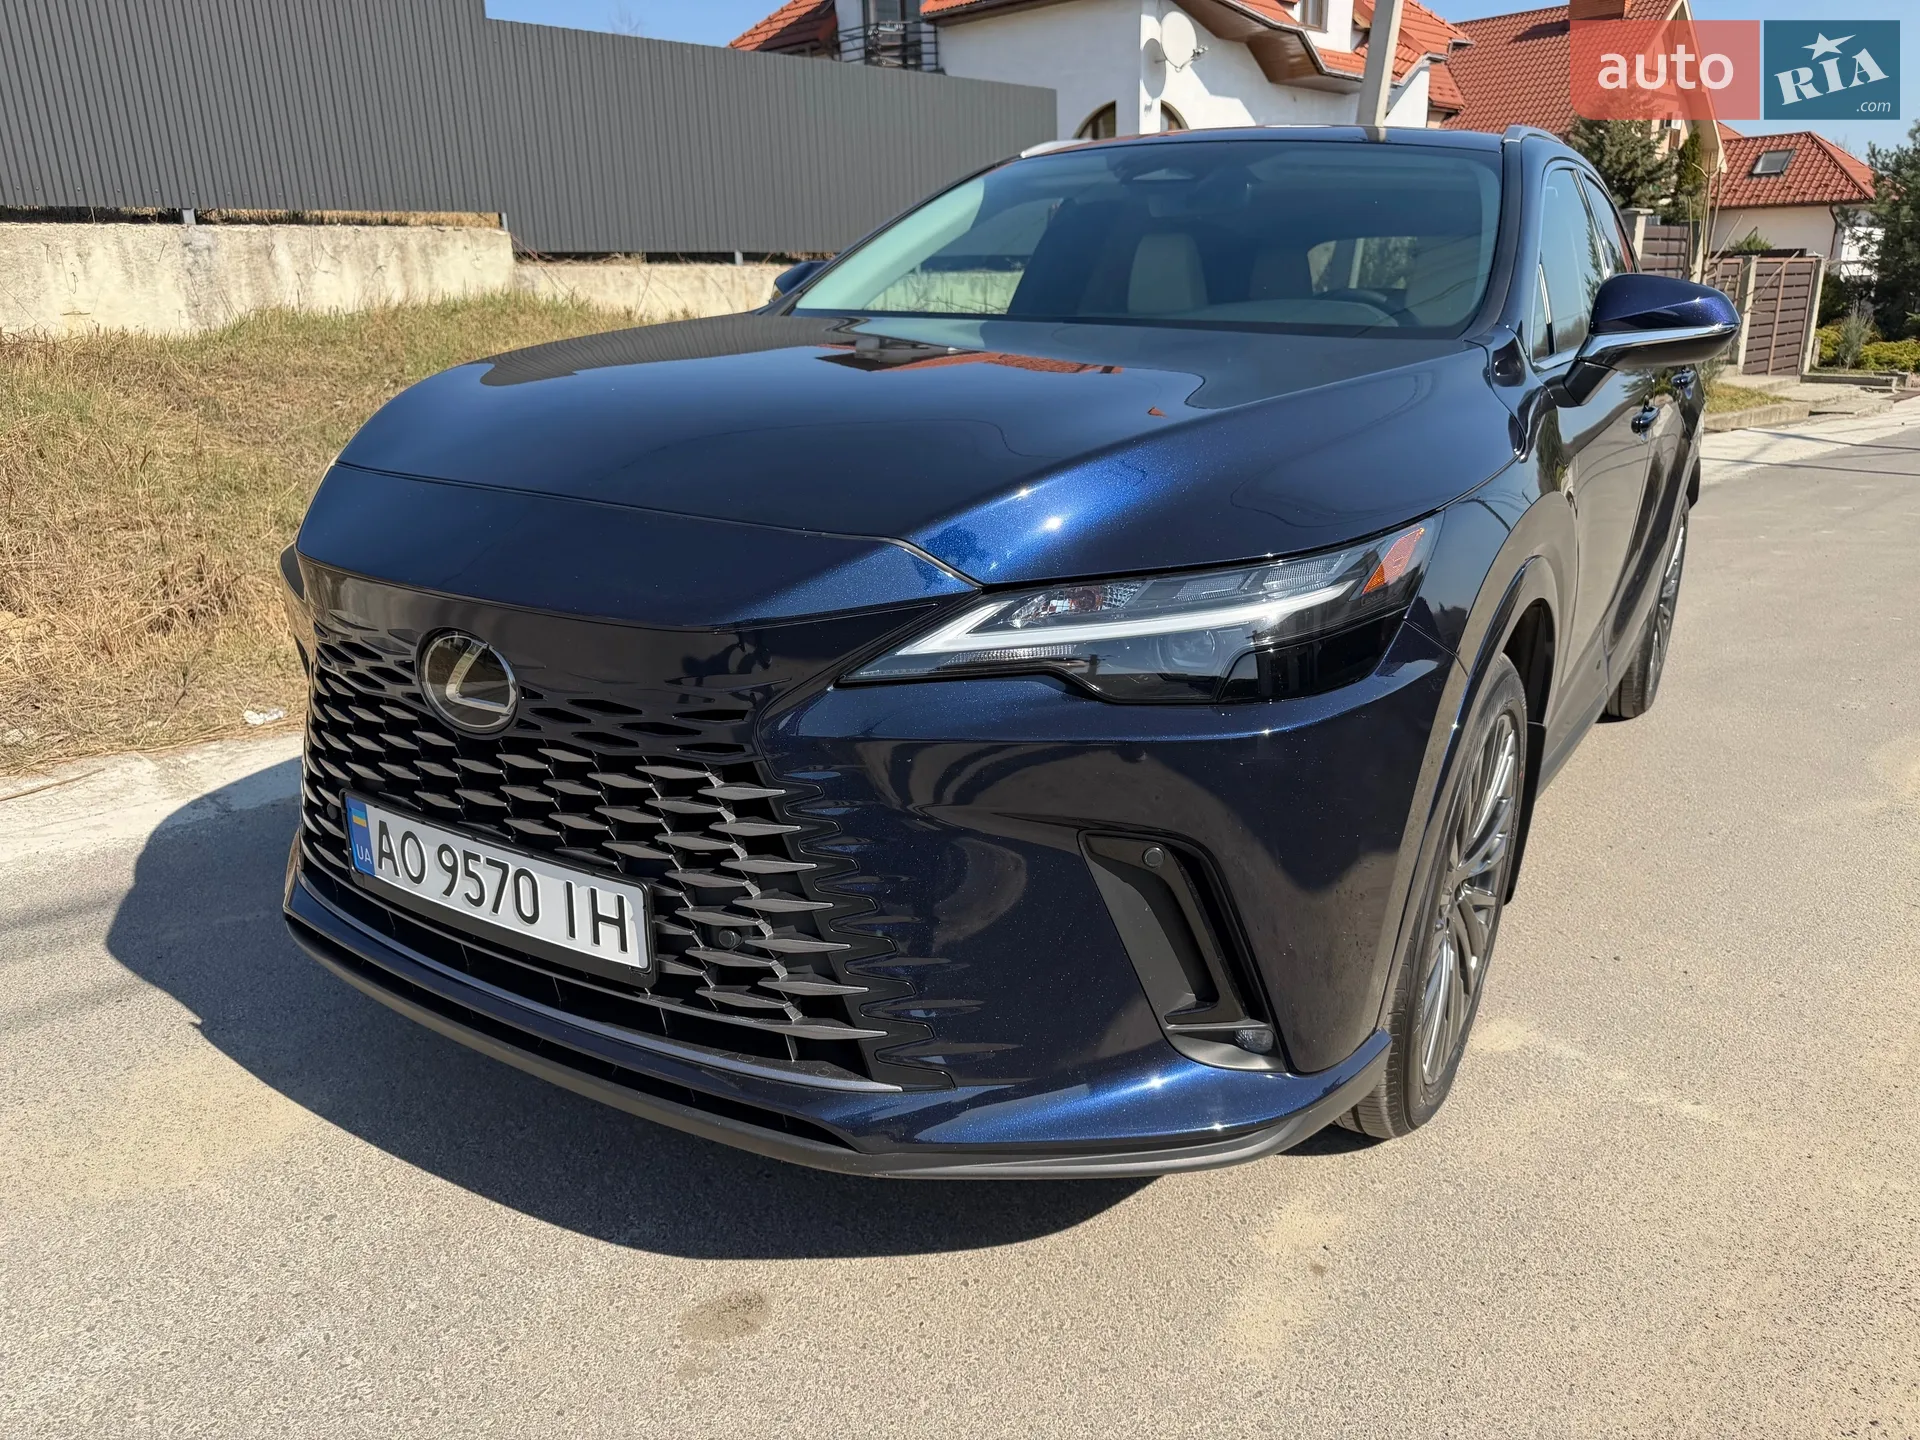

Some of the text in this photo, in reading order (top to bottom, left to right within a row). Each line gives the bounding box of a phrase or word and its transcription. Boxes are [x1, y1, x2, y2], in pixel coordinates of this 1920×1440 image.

[356, 843, 373, 864] UA
[378, 820, 628, 953] AO 9570 IH
